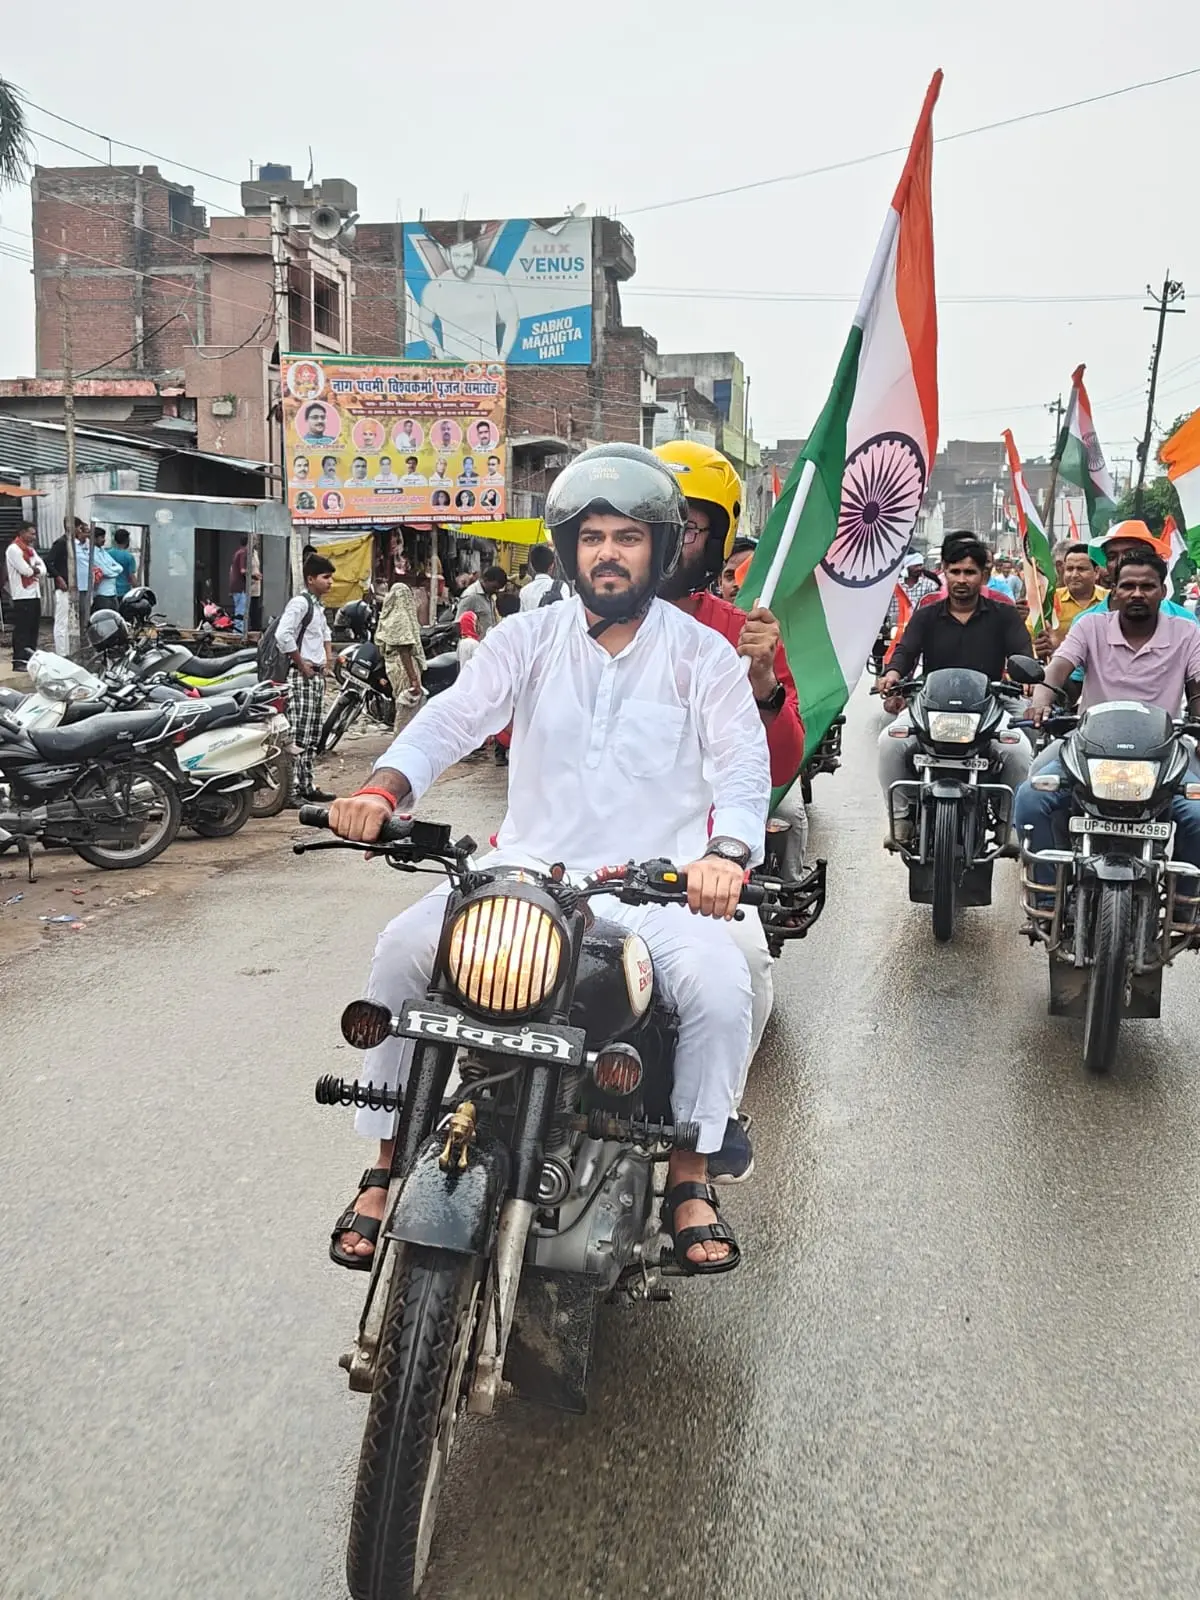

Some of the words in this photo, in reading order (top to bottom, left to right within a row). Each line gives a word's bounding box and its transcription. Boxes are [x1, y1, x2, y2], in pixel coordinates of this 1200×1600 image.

[532, 244, 572, 255] LUX
[519, 256, 585, 273] VENUS
[531, 316, 573, 336] SABKO
[522, 327, 583, 350] MAANGTA
[539, 343, 565, 360] HAI!
[331, 379, 353, 393] नाग
[387, 377, 433, 394] विश्वकर्मा
[436, 381, 460, 398] पूजन
[464, 379, 498, 395] समारोह
